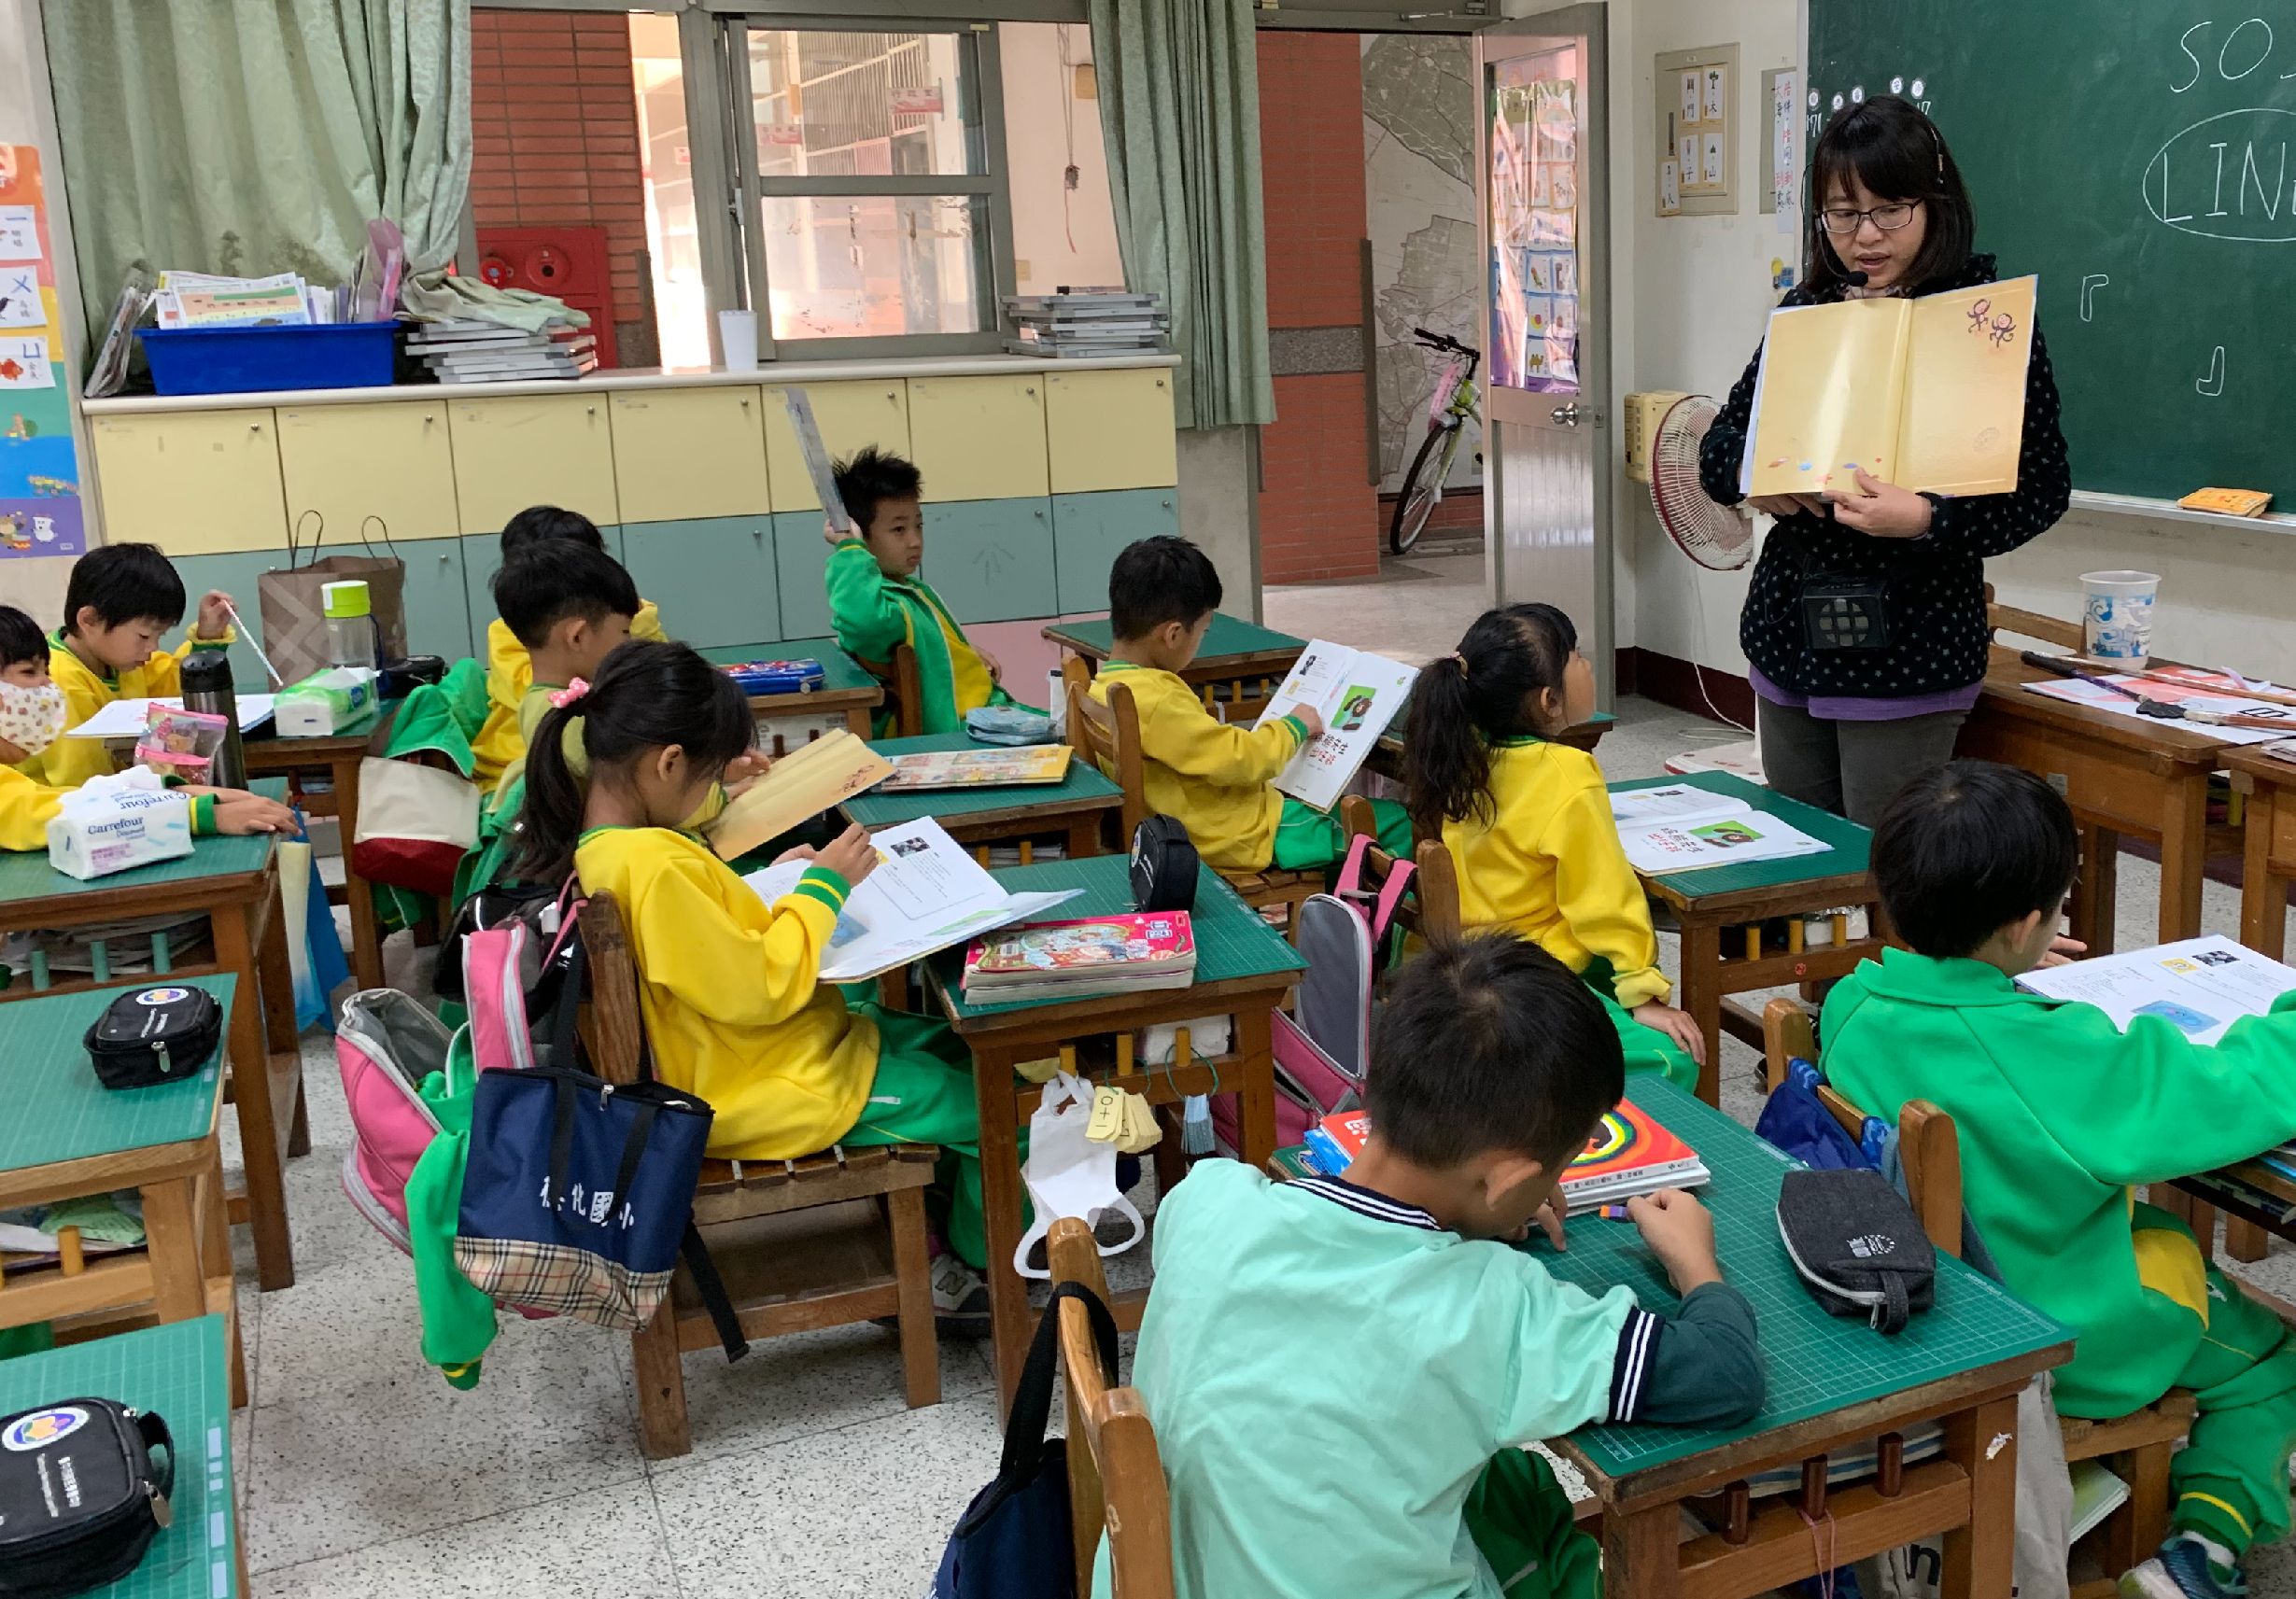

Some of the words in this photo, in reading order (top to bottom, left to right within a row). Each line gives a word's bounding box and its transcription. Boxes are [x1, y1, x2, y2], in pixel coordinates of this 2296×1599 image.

[2169, 18, 2296, 93] SO
[120, 793, 188, 810] Carrefour
[88, 817, 144, 835] Carrefour
